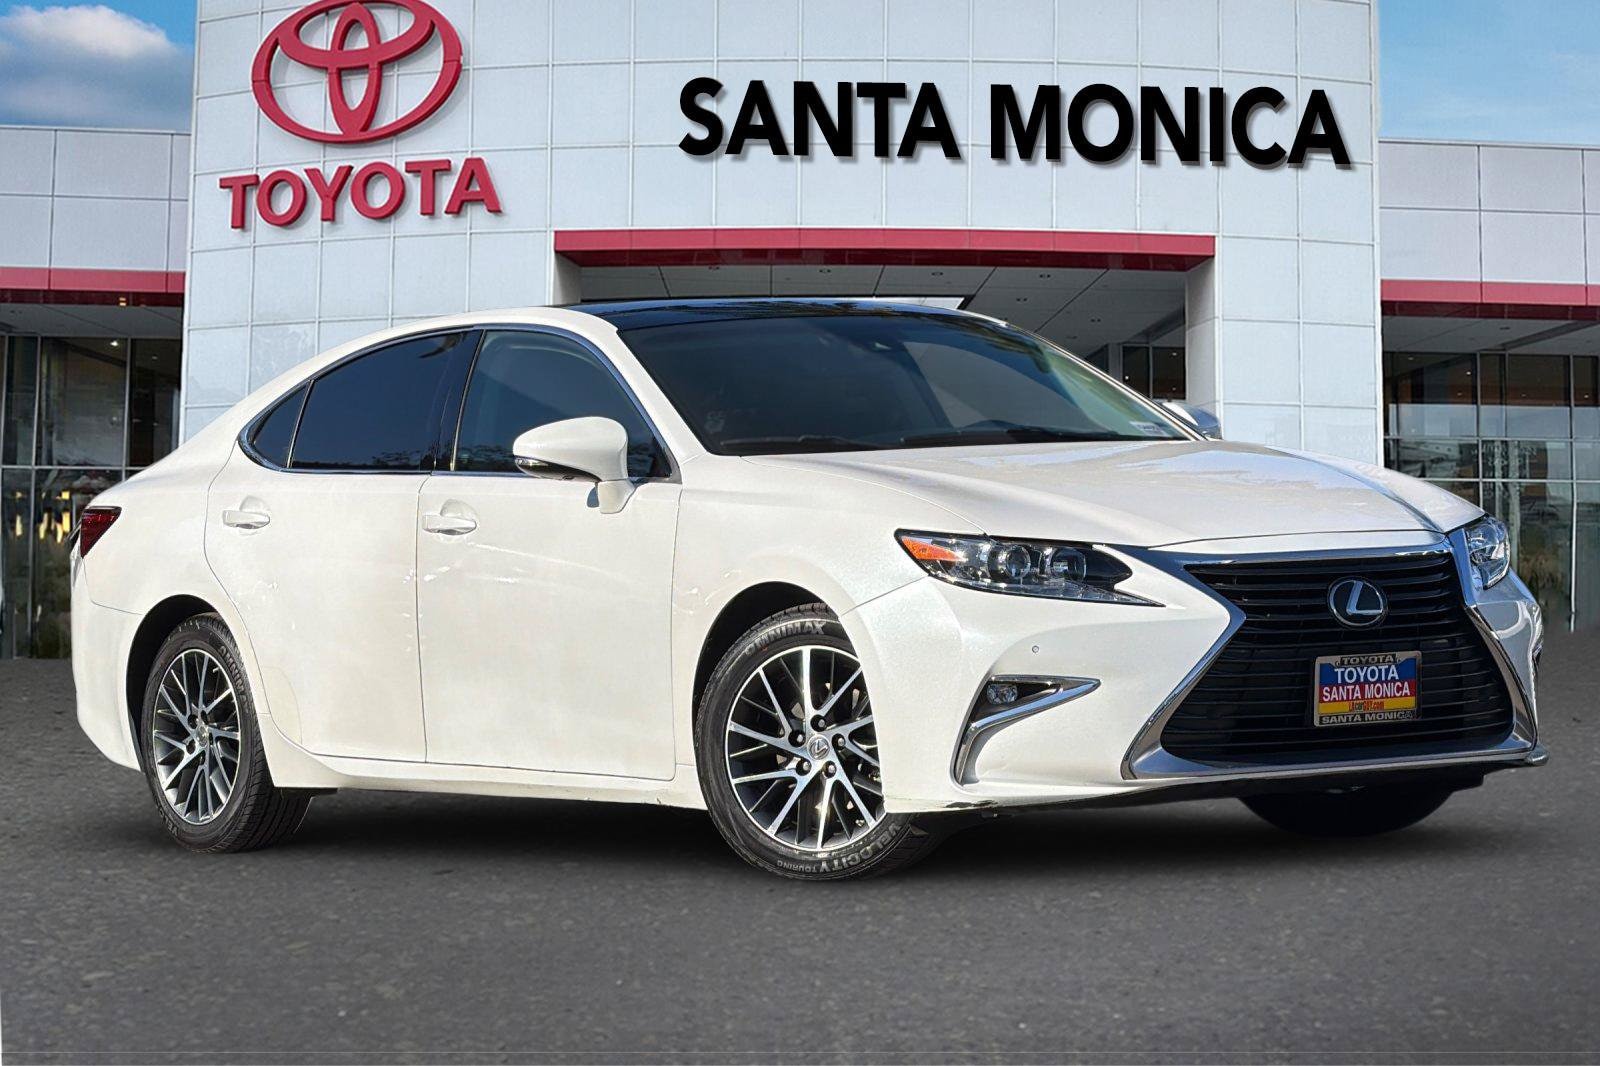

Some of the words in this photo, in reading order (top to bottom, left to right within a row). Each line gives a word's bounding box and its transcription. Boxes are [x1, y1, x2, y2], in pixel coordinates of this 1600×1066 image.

[678, 77, 962, 160] SANTA
[990, 83, 1351, 169] MONICA
[219, 157, 502, 229] TOYOTA
[1342, 654, 1394, 666] TOYOTA
[1334, 665, 1399, 683] TOYOTA
[1322, 685, 1361, 702] SANTA
[1365, 681, 1410, 698] MONICA
[1322, 713, 1361, 724] SANTA
[820, 823, 901, 872] VELOCITY
[777, 860, 817, 873] TOURING
